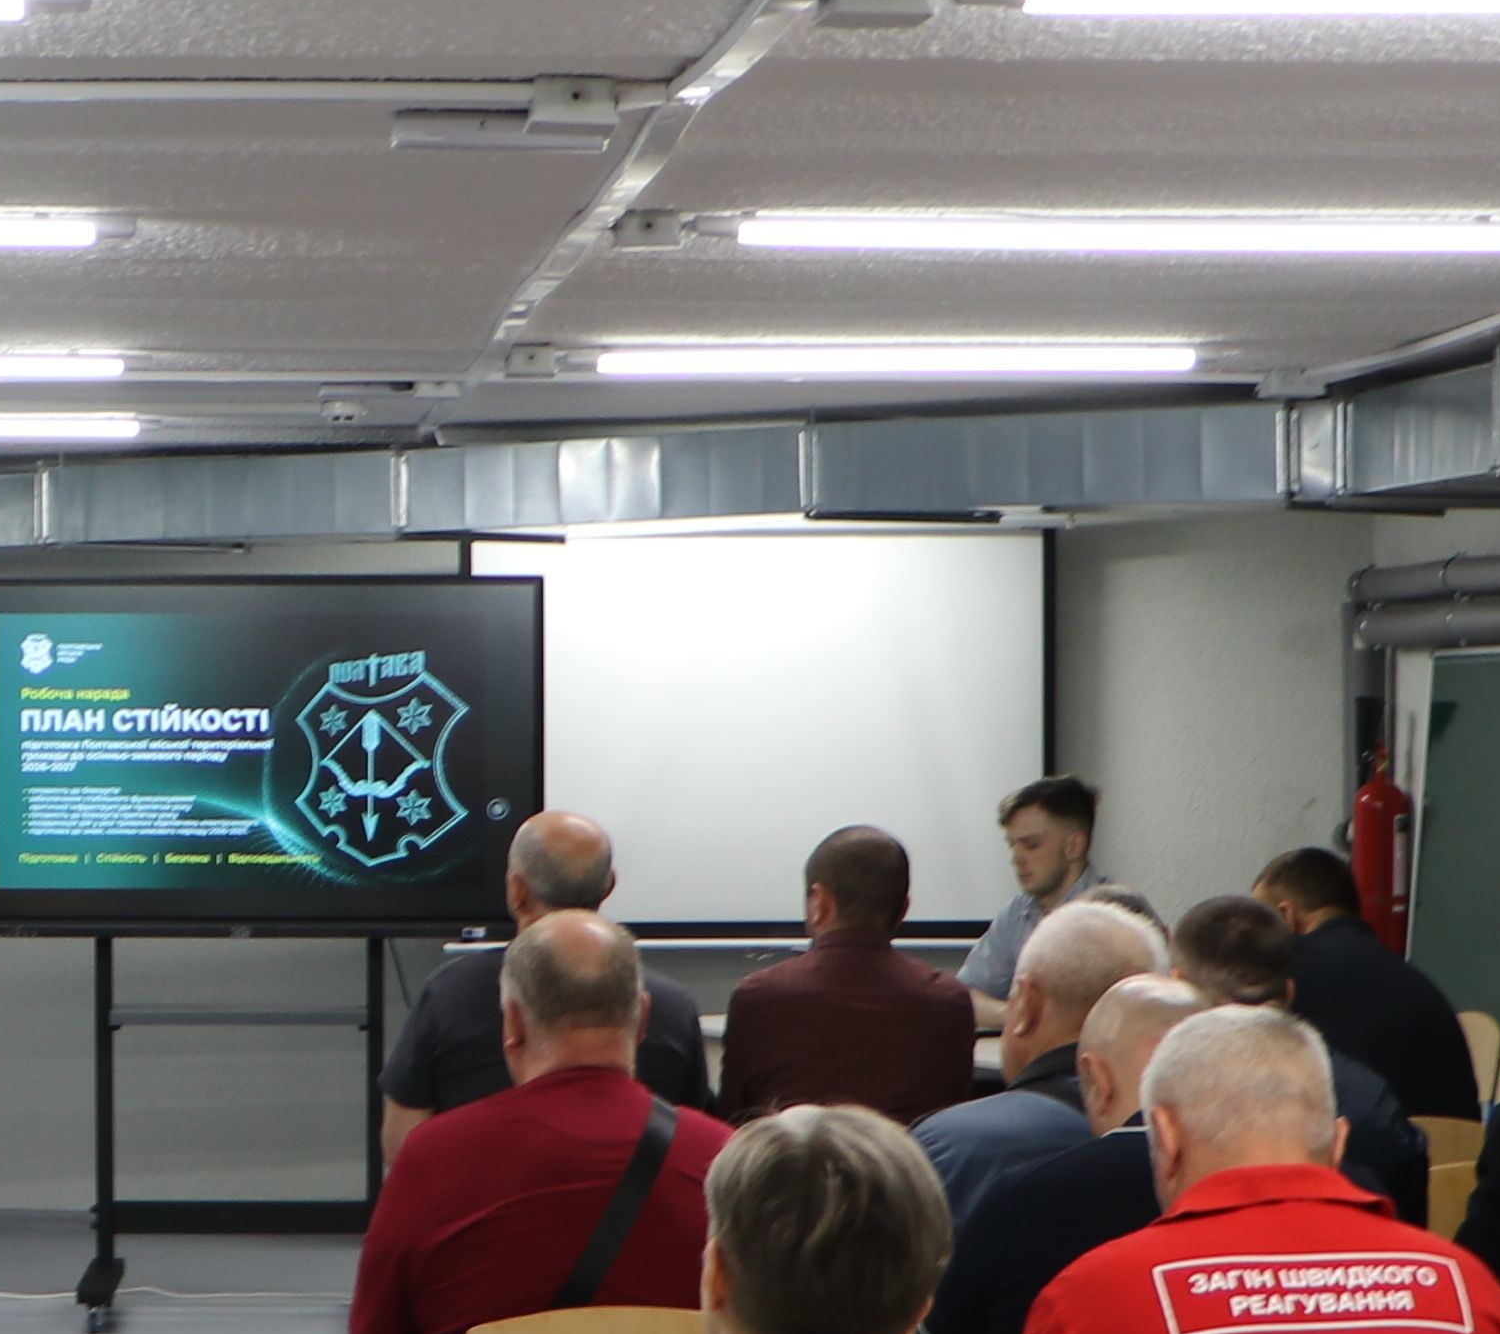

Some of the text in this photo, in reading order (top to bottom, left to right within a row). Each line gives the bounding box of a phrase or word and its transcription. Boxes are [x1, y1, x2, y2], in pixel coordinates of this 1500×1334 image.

[20, 687, 131, 702] Робоча нарада
[20, 703, 270, 732] ПЛАН СТІЙКОСТІ
[1187, 1264, 1438, 1295] ЗАГІН ШВИДКОГО
[1229, 1289, 1415, 1317] РЕАГУВАННЯ
